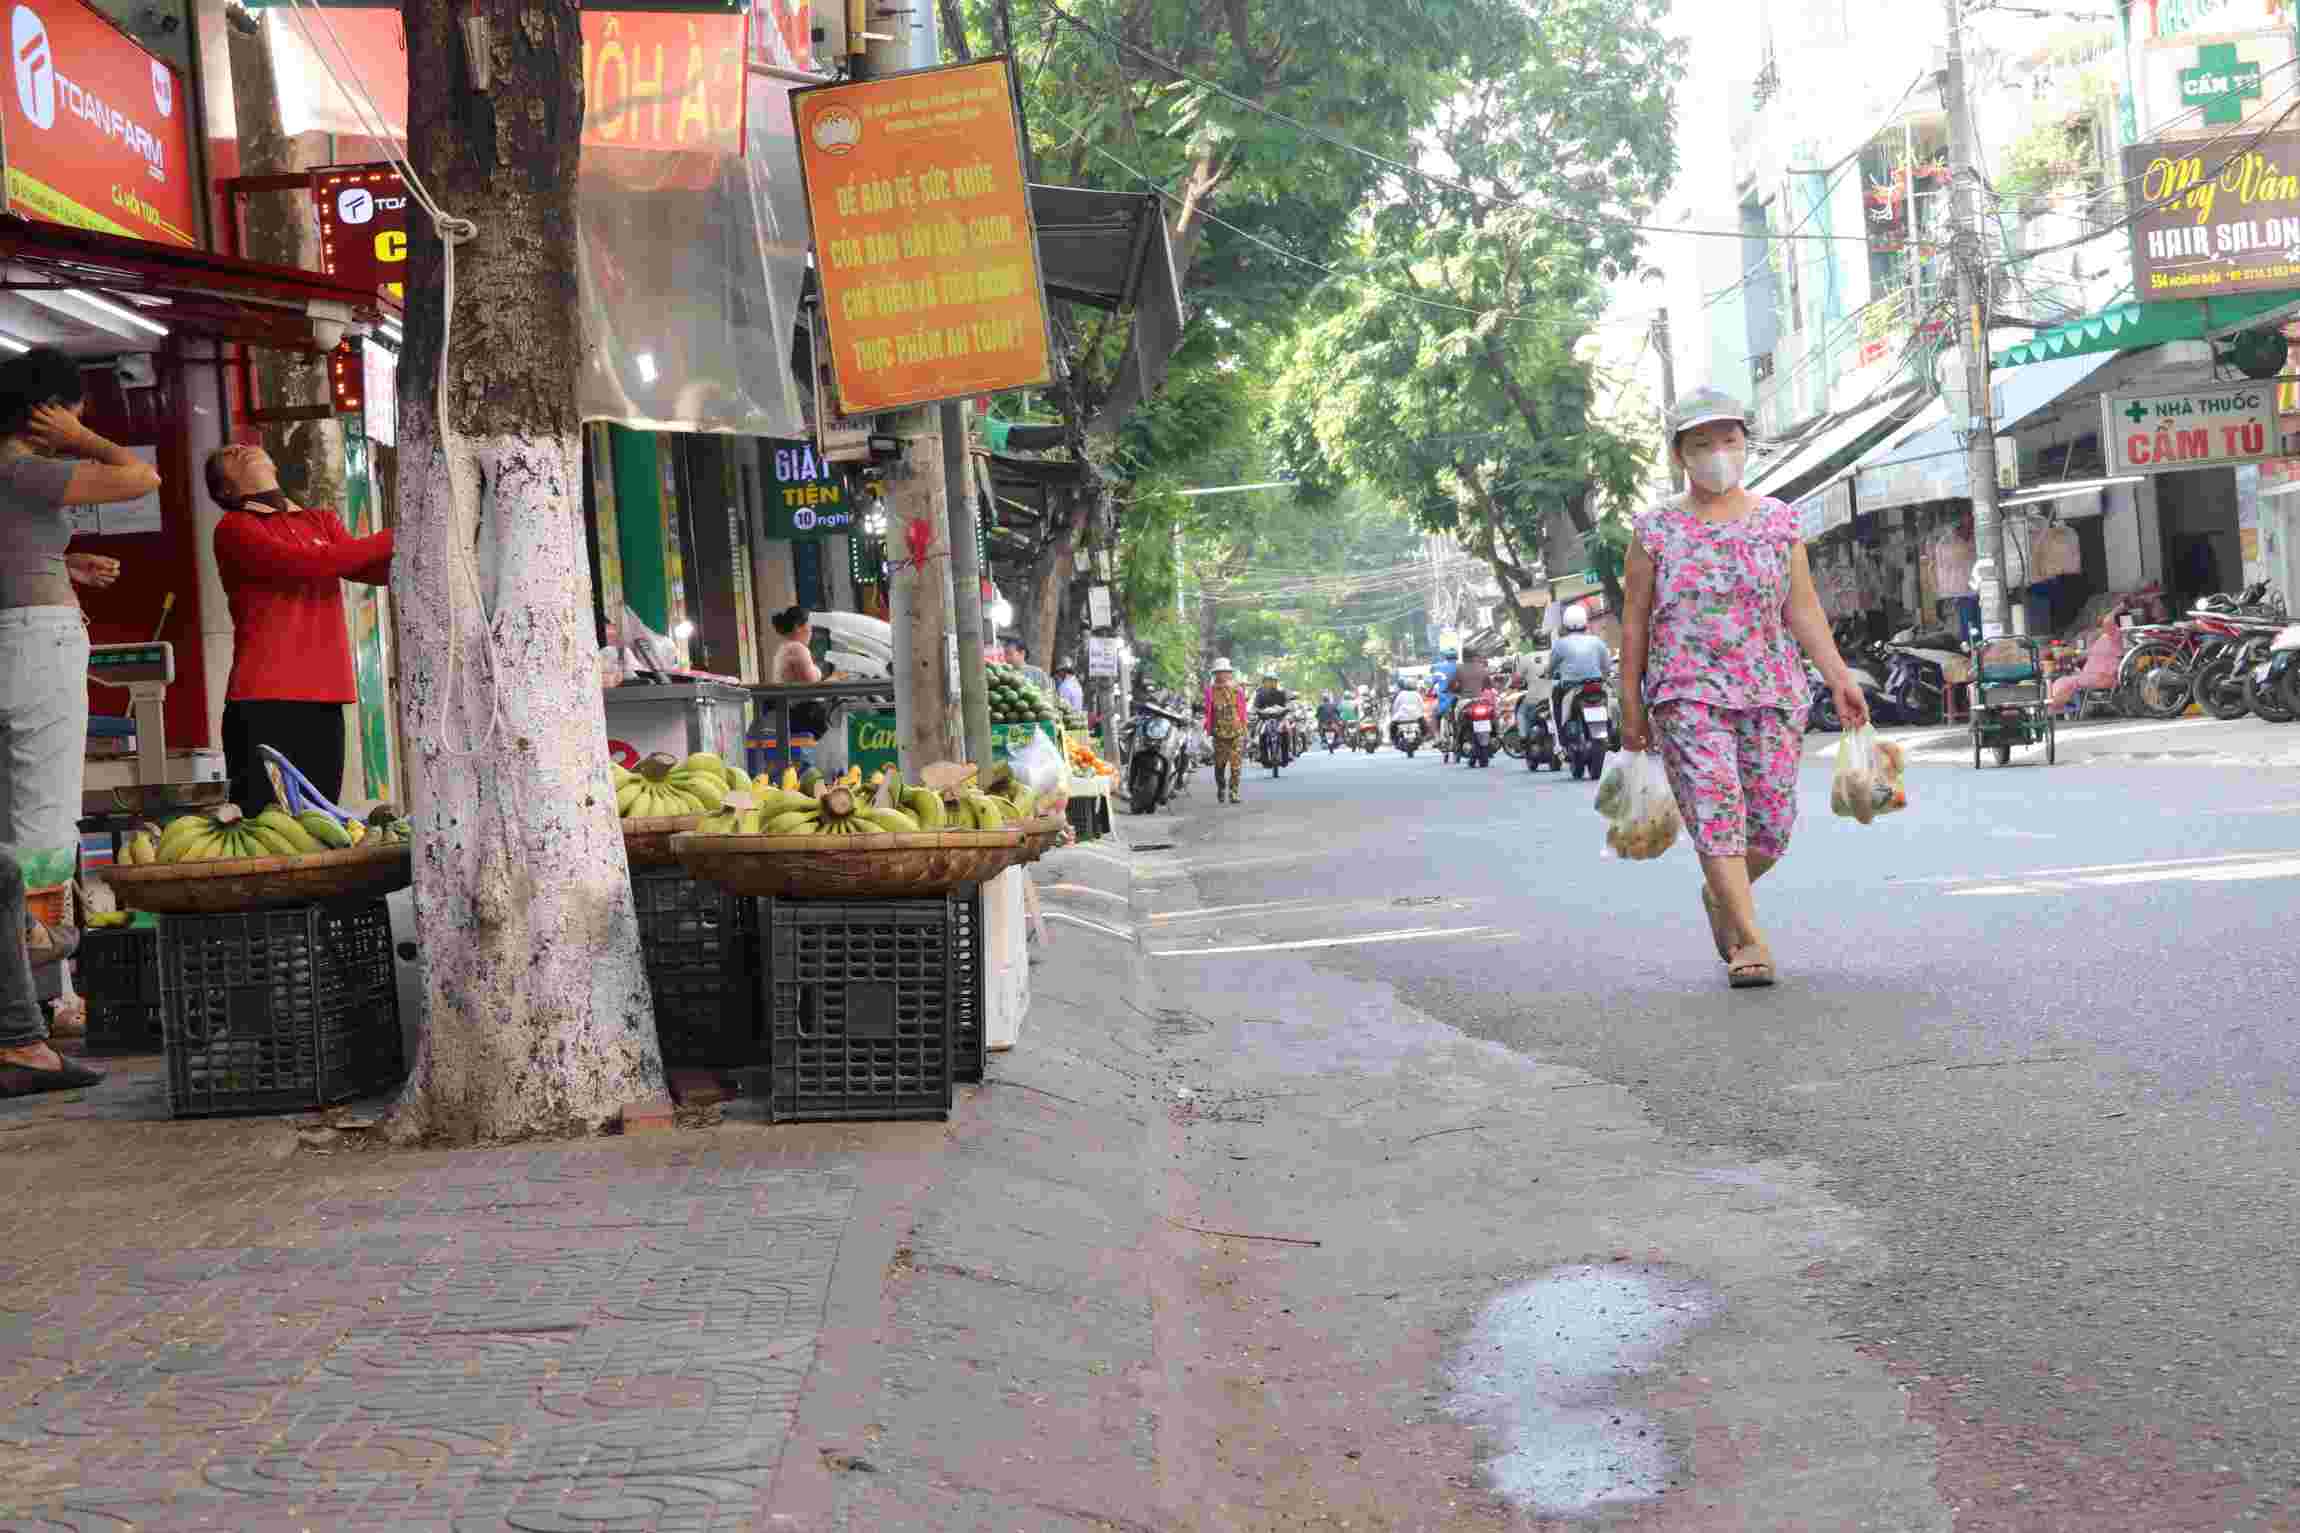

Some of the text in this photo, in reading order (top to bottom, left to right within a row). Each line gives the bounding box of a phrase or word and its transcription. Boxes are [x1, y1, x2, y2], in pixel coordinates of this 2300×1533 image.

[2221, 150, 2298, 204] Vân
[2148, 217, 2300, 259] HAIR SALON
[2198, 391, 2260, 414] THUỐC
[2221, 418, 2265, 456] TÚ
